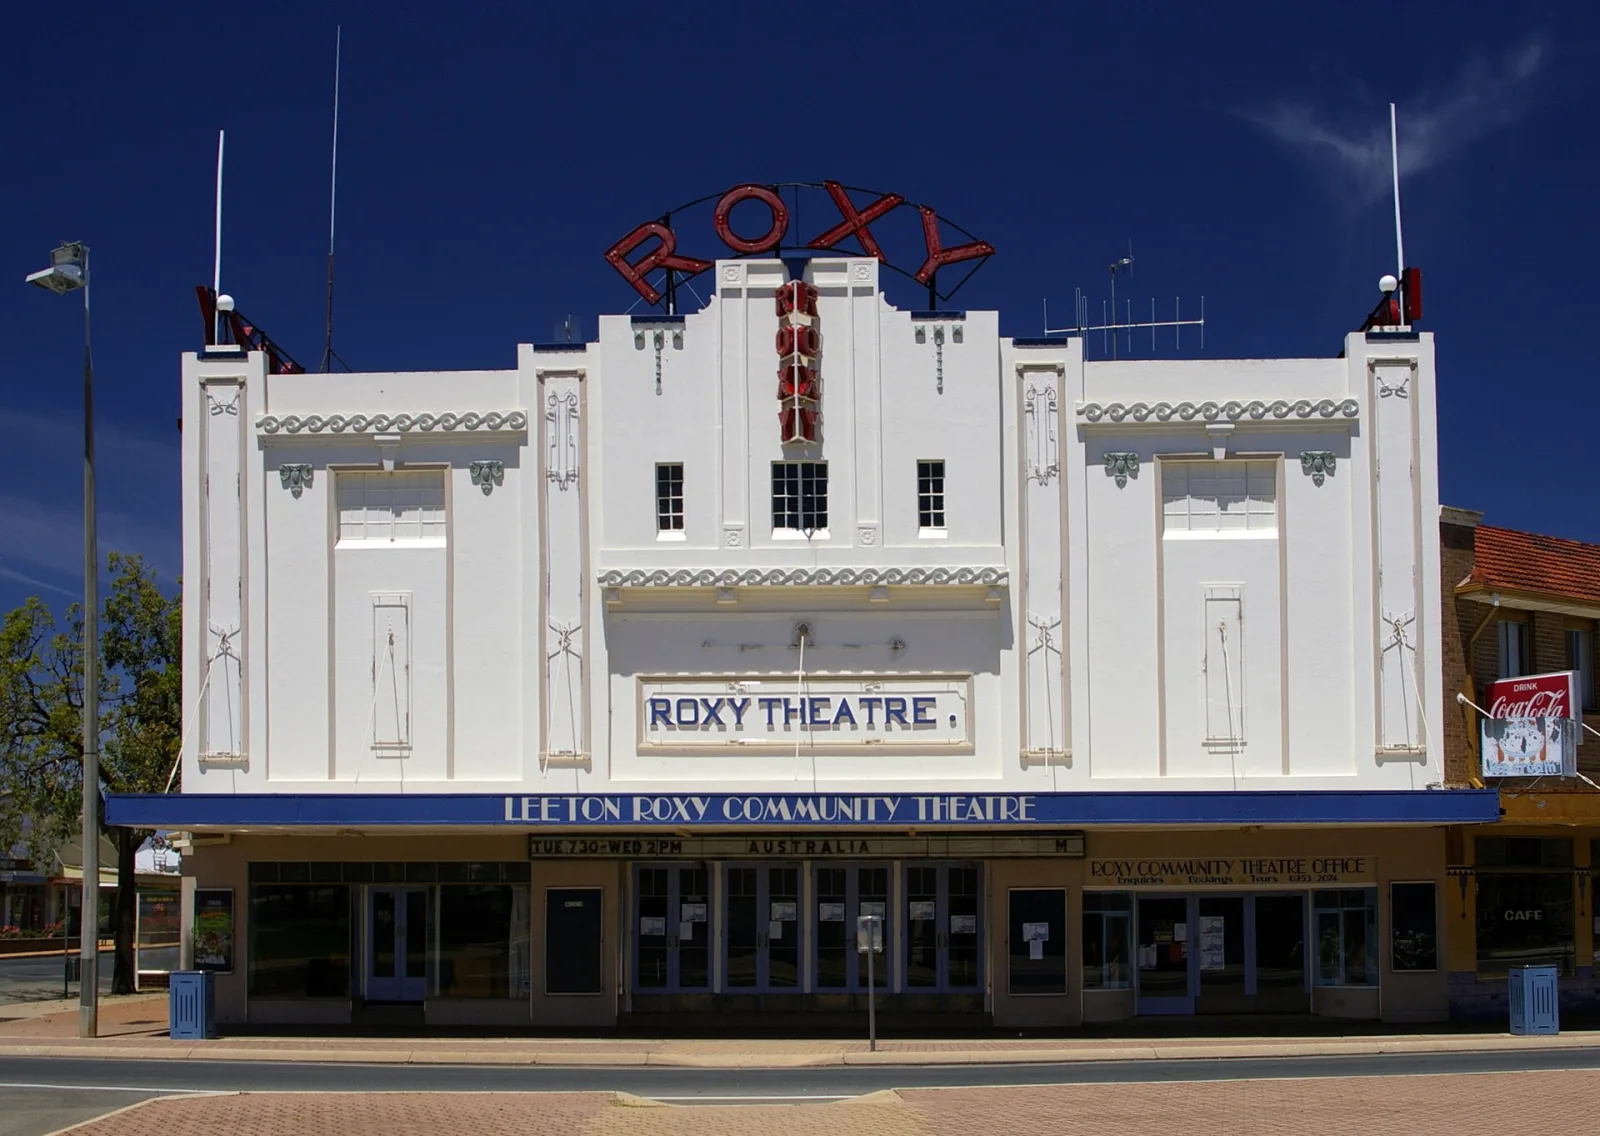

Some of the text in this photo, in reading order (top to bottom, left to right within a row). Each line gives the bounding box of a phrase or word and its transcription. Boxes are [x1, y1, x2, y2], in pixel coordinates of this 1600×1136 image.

[604, 179, 996, 306] ROXY
[1513, 682, 1538, 693] DRINK
[650, 697, 937, 726] ROXY THEATRE
[504, 796, 1036, 821] LEETON ROXY COMMUNITY THEATRE
[532, 840, 563, 854] TUE
[749, 840, 870, 854] AUSTRALIA
[1055, 839, 1068, 853] M
[1091, 858, 1365, 877] ROXY COMMUNITY THEATRE OFFICE
[1504, 909, 1543, 921] CAFE
